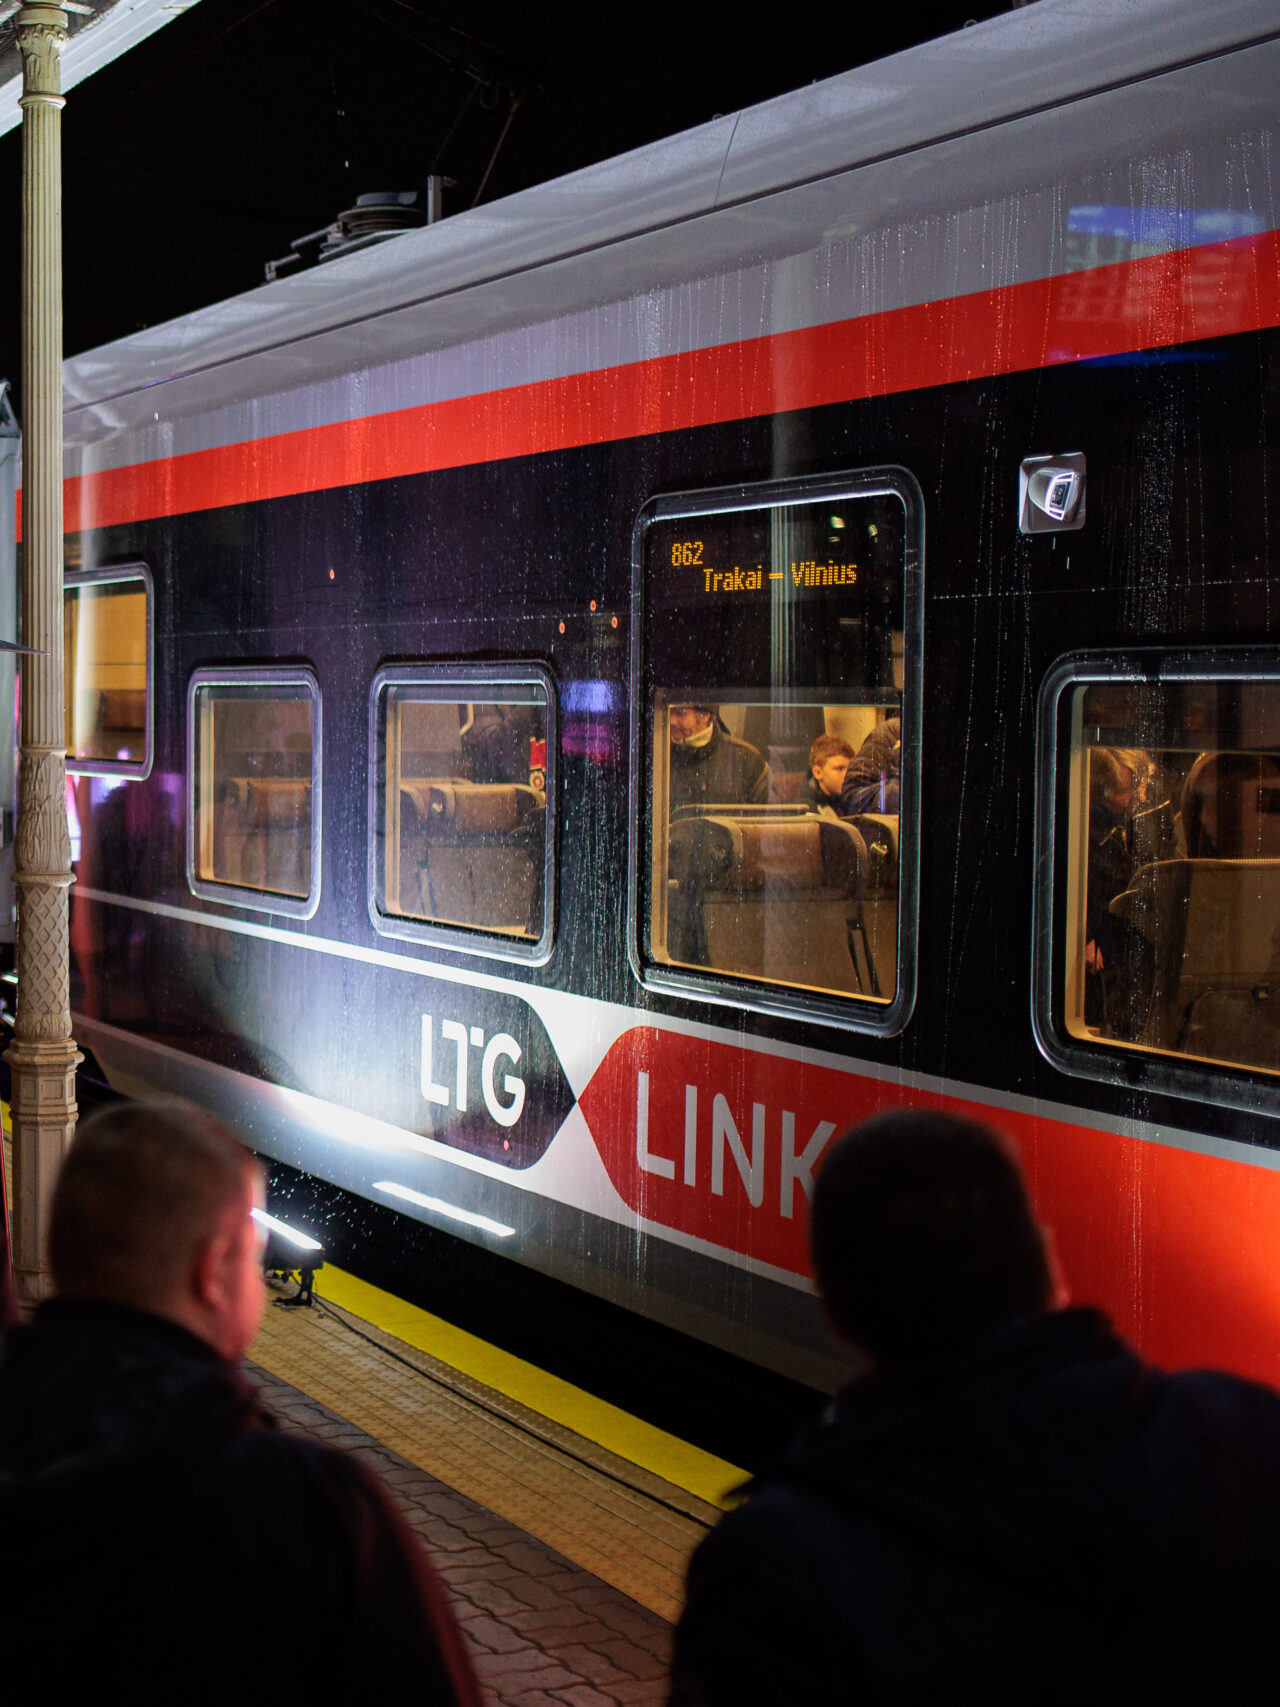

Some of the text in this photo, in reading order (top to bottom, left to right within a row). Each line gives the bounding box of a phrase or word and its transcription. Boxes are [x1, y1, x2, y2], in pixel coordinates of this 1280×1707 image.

[671, 541, 703, 567] 862
[703, 565, 763, 592] Trakai
[791, 560, 857, 587] Vilnius
[421, 1013, 837, 1219] LTG LINK
